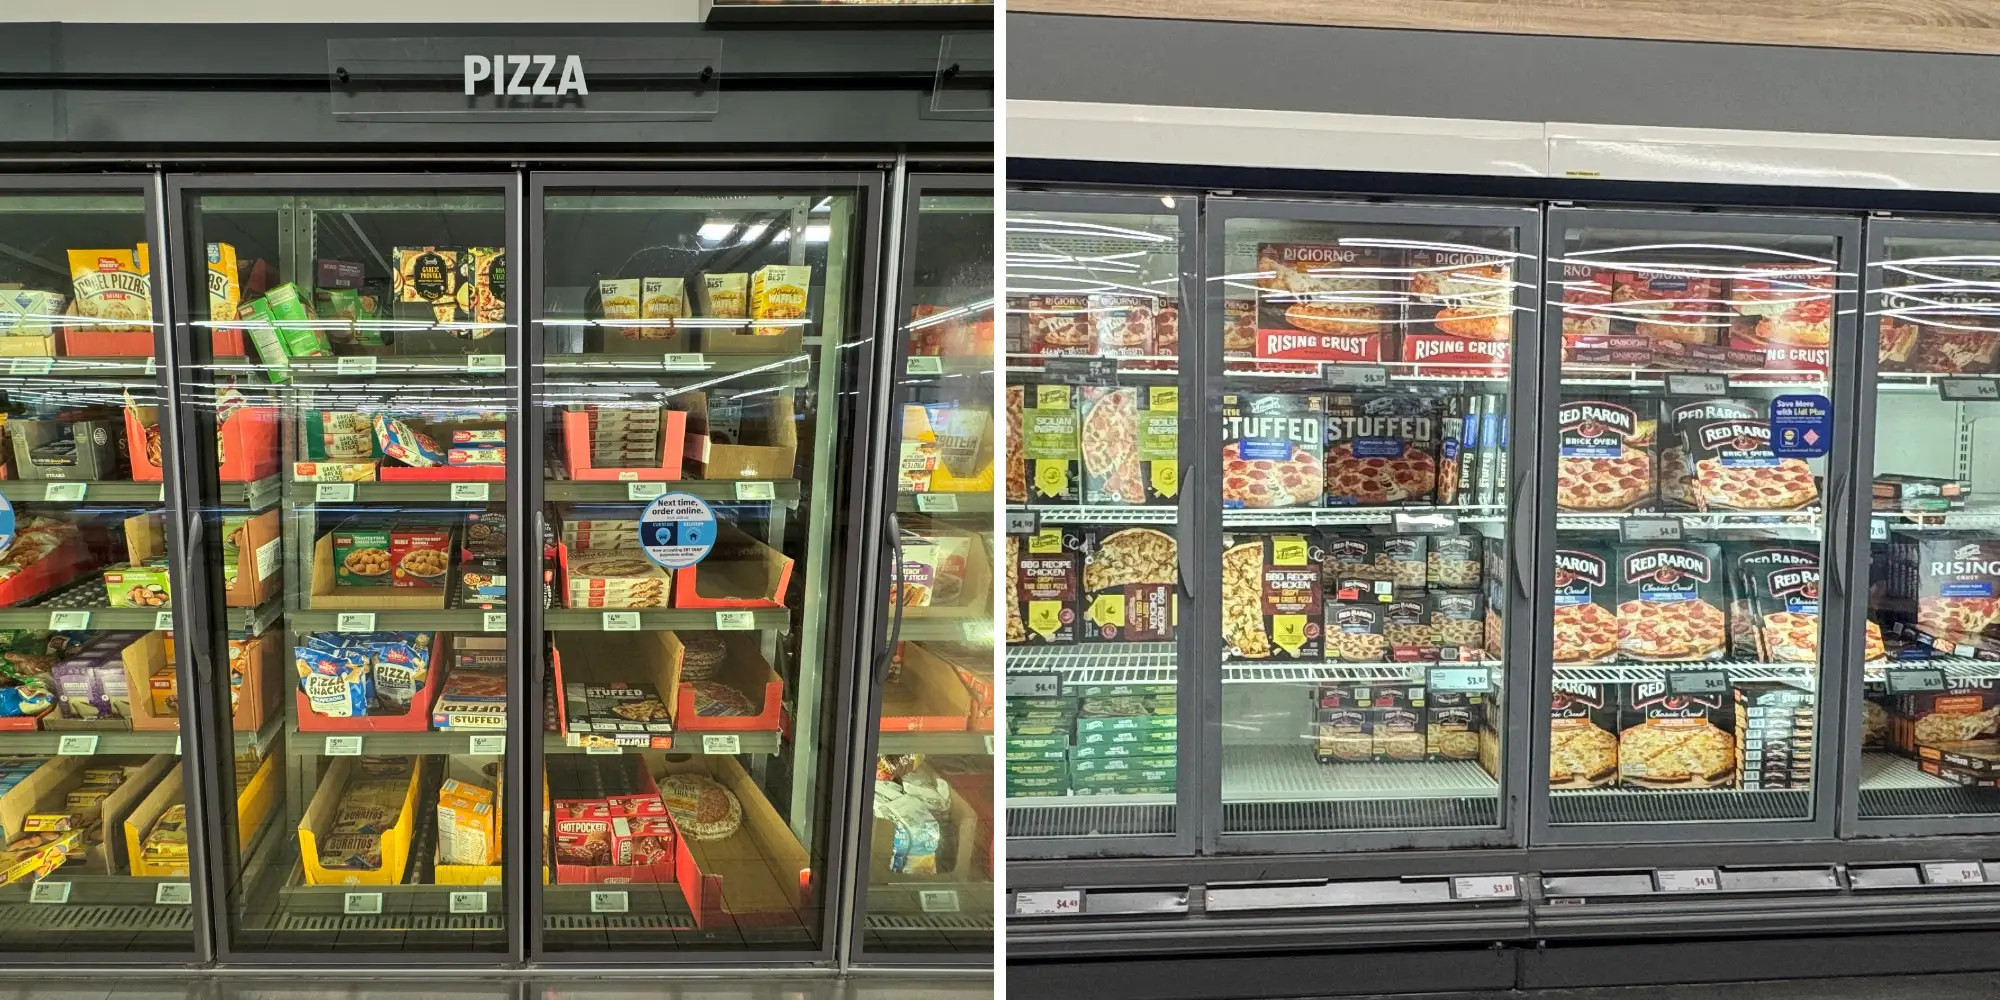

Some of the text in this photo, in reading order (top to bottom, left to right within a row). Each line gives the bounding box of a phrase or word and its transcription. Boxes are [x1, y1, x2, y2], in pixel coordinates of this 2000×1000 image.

[464, 54, 589, 96] PIZZA
[1284, 247, 1356, 262] DIGIORNO
[111, 274, 145, 296] PIZZAS
[769, 295, 803, 304] WAFFLES
[1267, 334, 1367, 357] RISING CRUST
[1415, 339, 1464, 360] RISING
[1776, 399, 1814, 407] Save More
[1582, 406, 1630, 428] BARON
[1776, 408, 1826, 416] with Lidl Plus
[1036, 417, 1071, 426] SICILIAN
[1034, 425, 1074, 434] INSPIRED
[1328, 416, 1431, 442] STUFFED
[1706, 428, 1731, 442] RED
[1565, 437, 1618, 446] BRICK OVEN
[657, 498, 698, 507] Next time,
[652, 507, 704, 515] order online.
[1020, 560, 1072, 568] BBQ RECIPE
[1556, 554, 1598, 575] BARON
[1630, 552, 1704, 574] RED BARON
[1931, 560, 2000, 576] RISING
[908, 573, 928, 581] STICKS
[1027, 568, 1066, 577] CHICKEN
[1266, 573, 1318, 581] BBQ RECIPE
[1271, 581, 1311, 589] CHICKEN
[1774, 574, 1800, 588] RED
[1642, 582, 1694, 592] Classic Crust
[376, 666, 410, 680] PIZZA
[310, 675, 345, 687] PIZZA
[376, 676, 411, 685] SNACKS
[309, 684, 346, 696] SNACKS
[1638, 682, 1665, 700] RED
[443, 705, 506, 713] TUFFED
[1650, 709, 1705, 719] Classic Crust
[454, 716, 501, 724] STUFFED
[344, 810, 384, 821] BURRITOS
[560, 822, 607, 833] HOT POCKETS
[330, 838, 373, 850] BURRITOS
